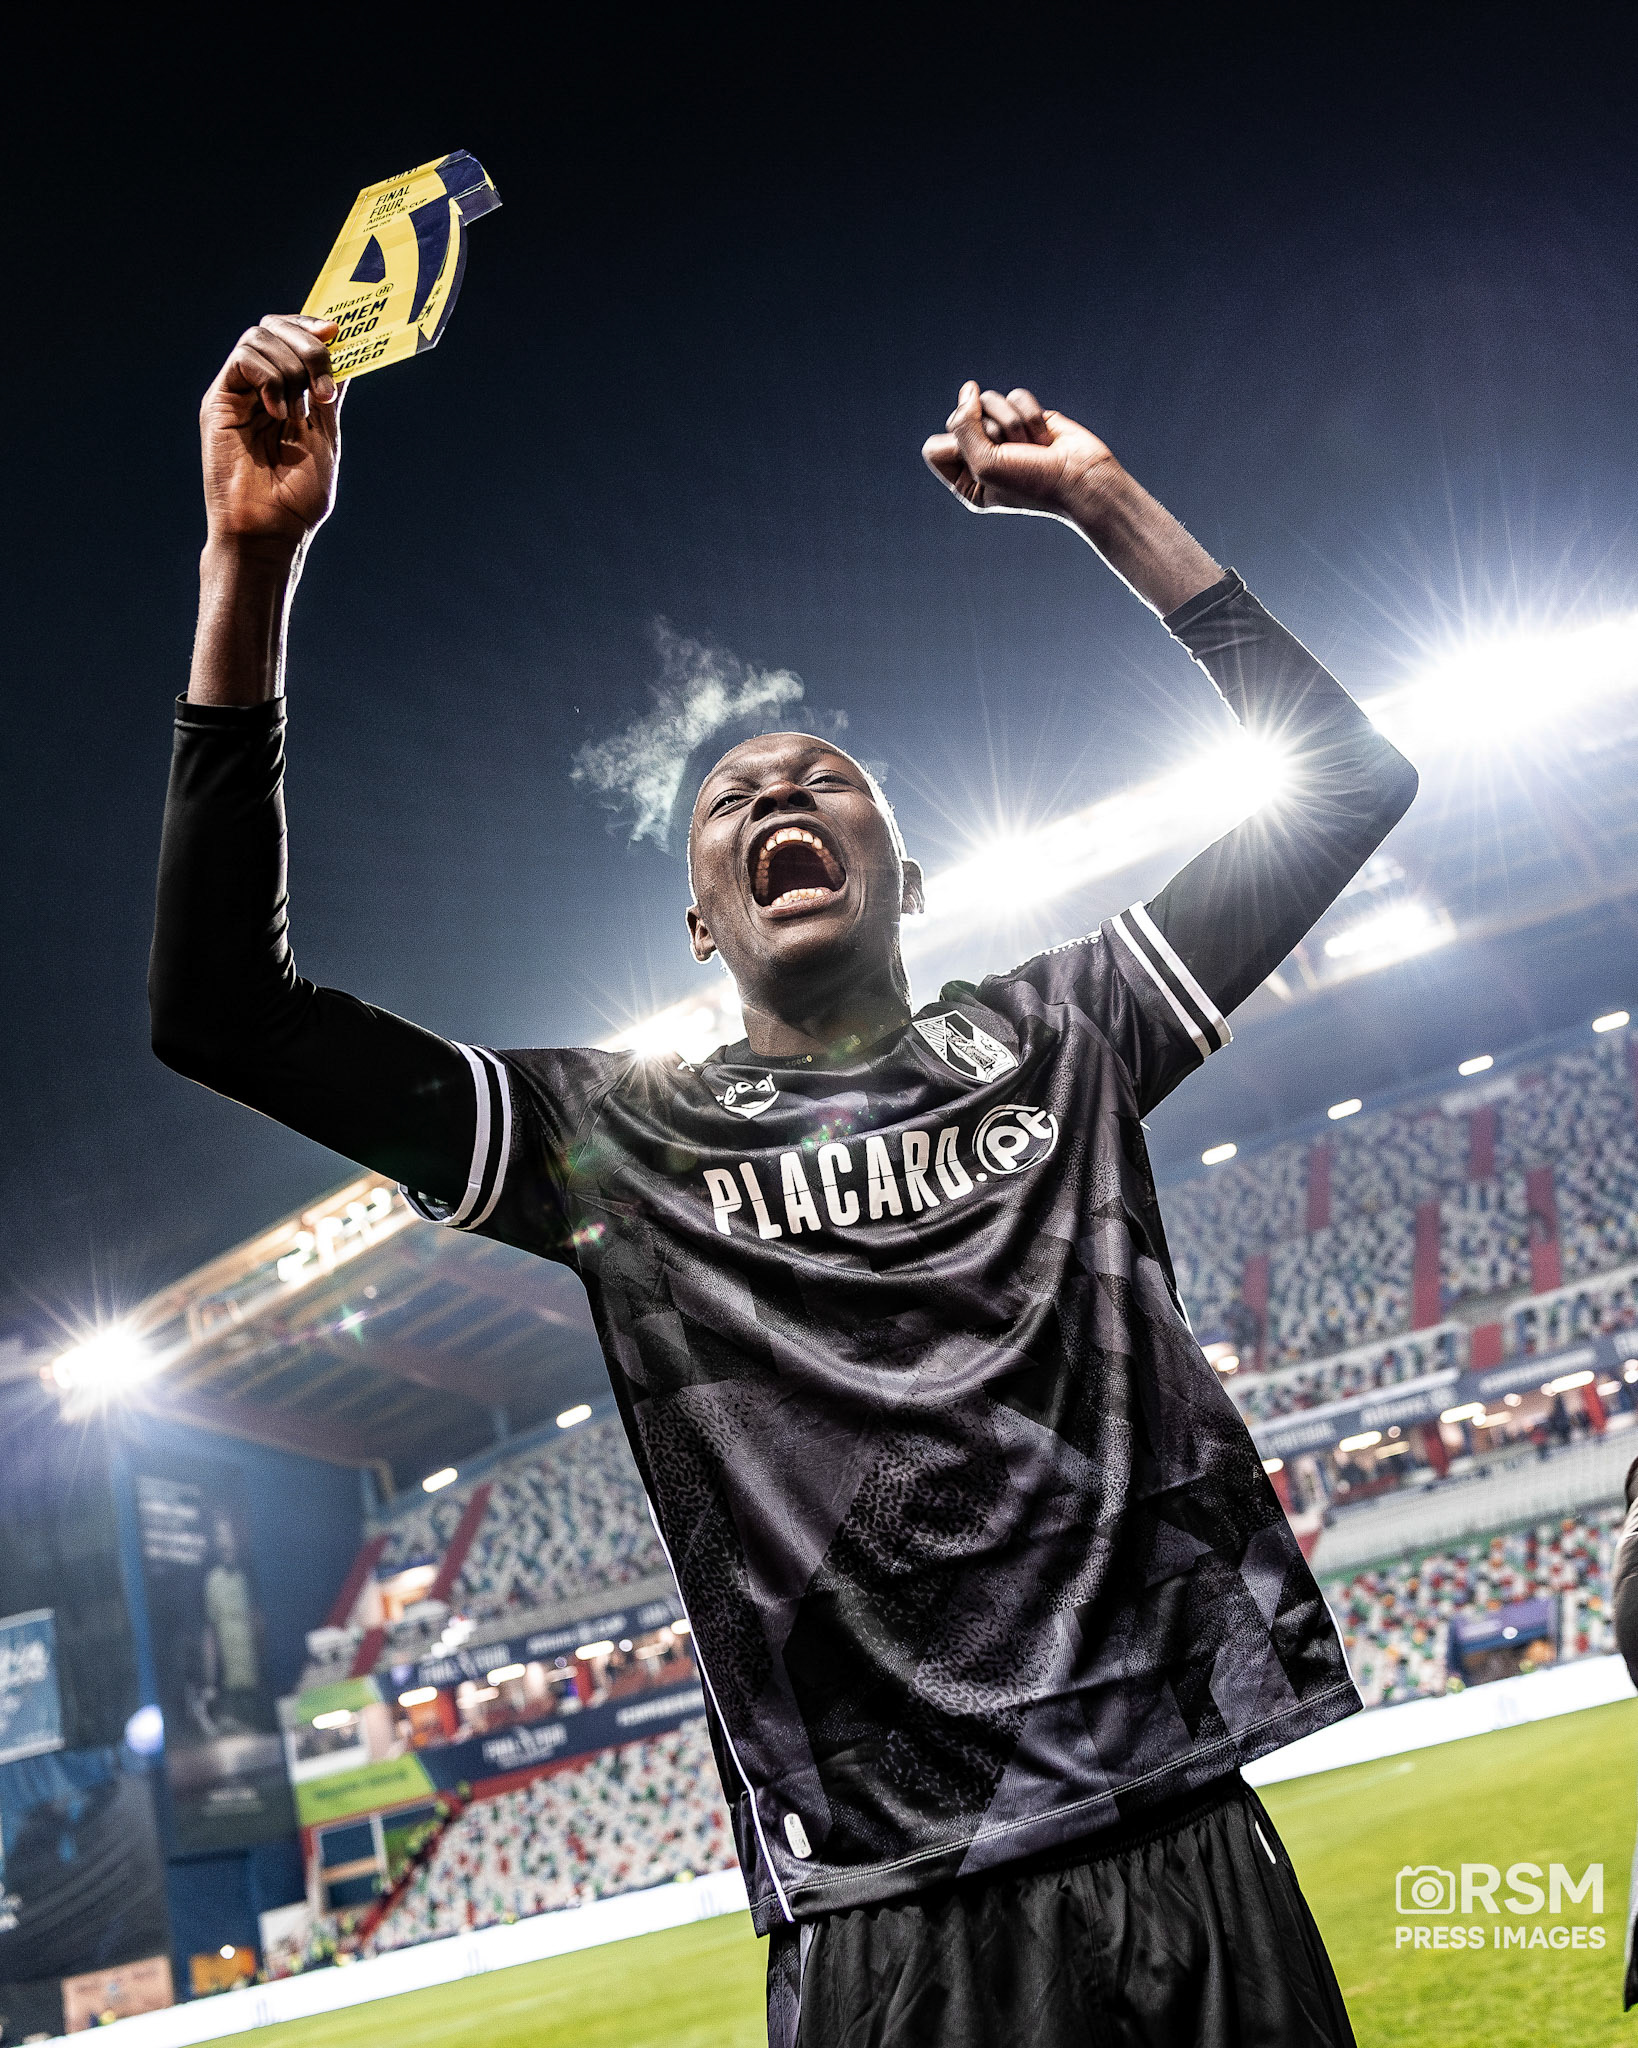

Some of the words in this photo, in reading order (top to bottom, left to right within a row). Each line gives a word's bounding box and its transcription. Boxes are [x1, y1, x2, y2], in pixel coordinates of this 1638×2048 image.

[376, 184, 410, 206] FINAL
[369, 197, 404, 219] FOUR
[323, 292, 373, 316] Allianz
